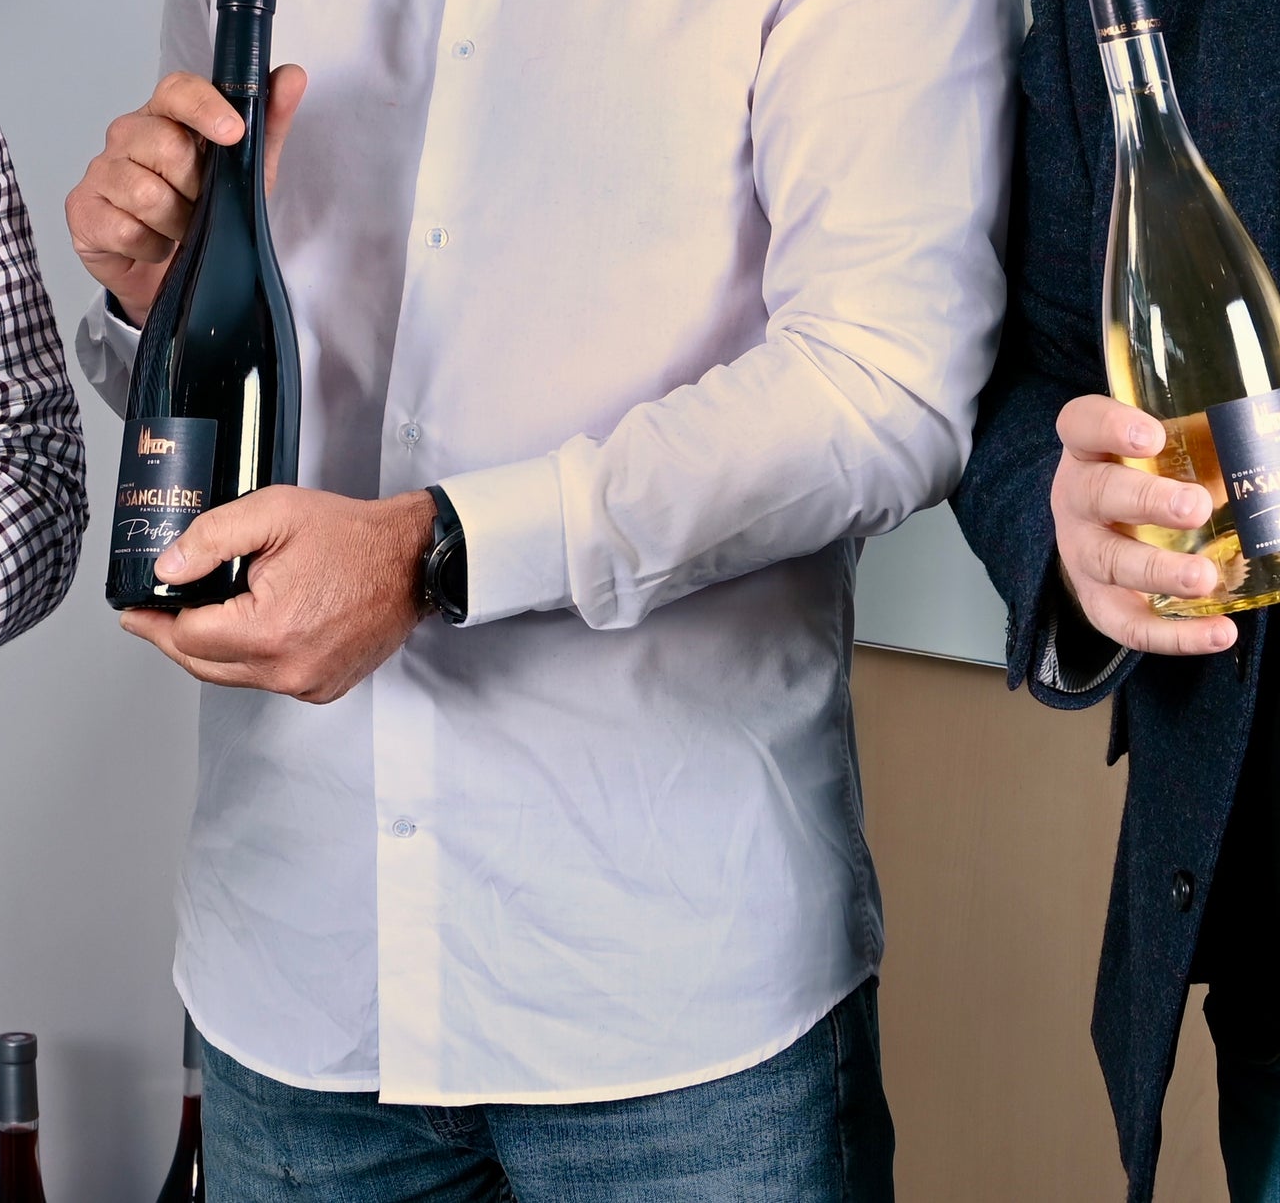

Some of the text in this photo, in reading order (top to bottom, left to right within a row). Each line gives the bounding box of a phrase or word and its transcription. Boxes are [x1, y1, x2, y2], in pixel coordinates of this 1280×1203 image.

[1231, 464, 1267, 480] DOMAINE
[125, 484, 203, 507] SANGLIÈRE
[117, 518, 181, 545] Prestige
